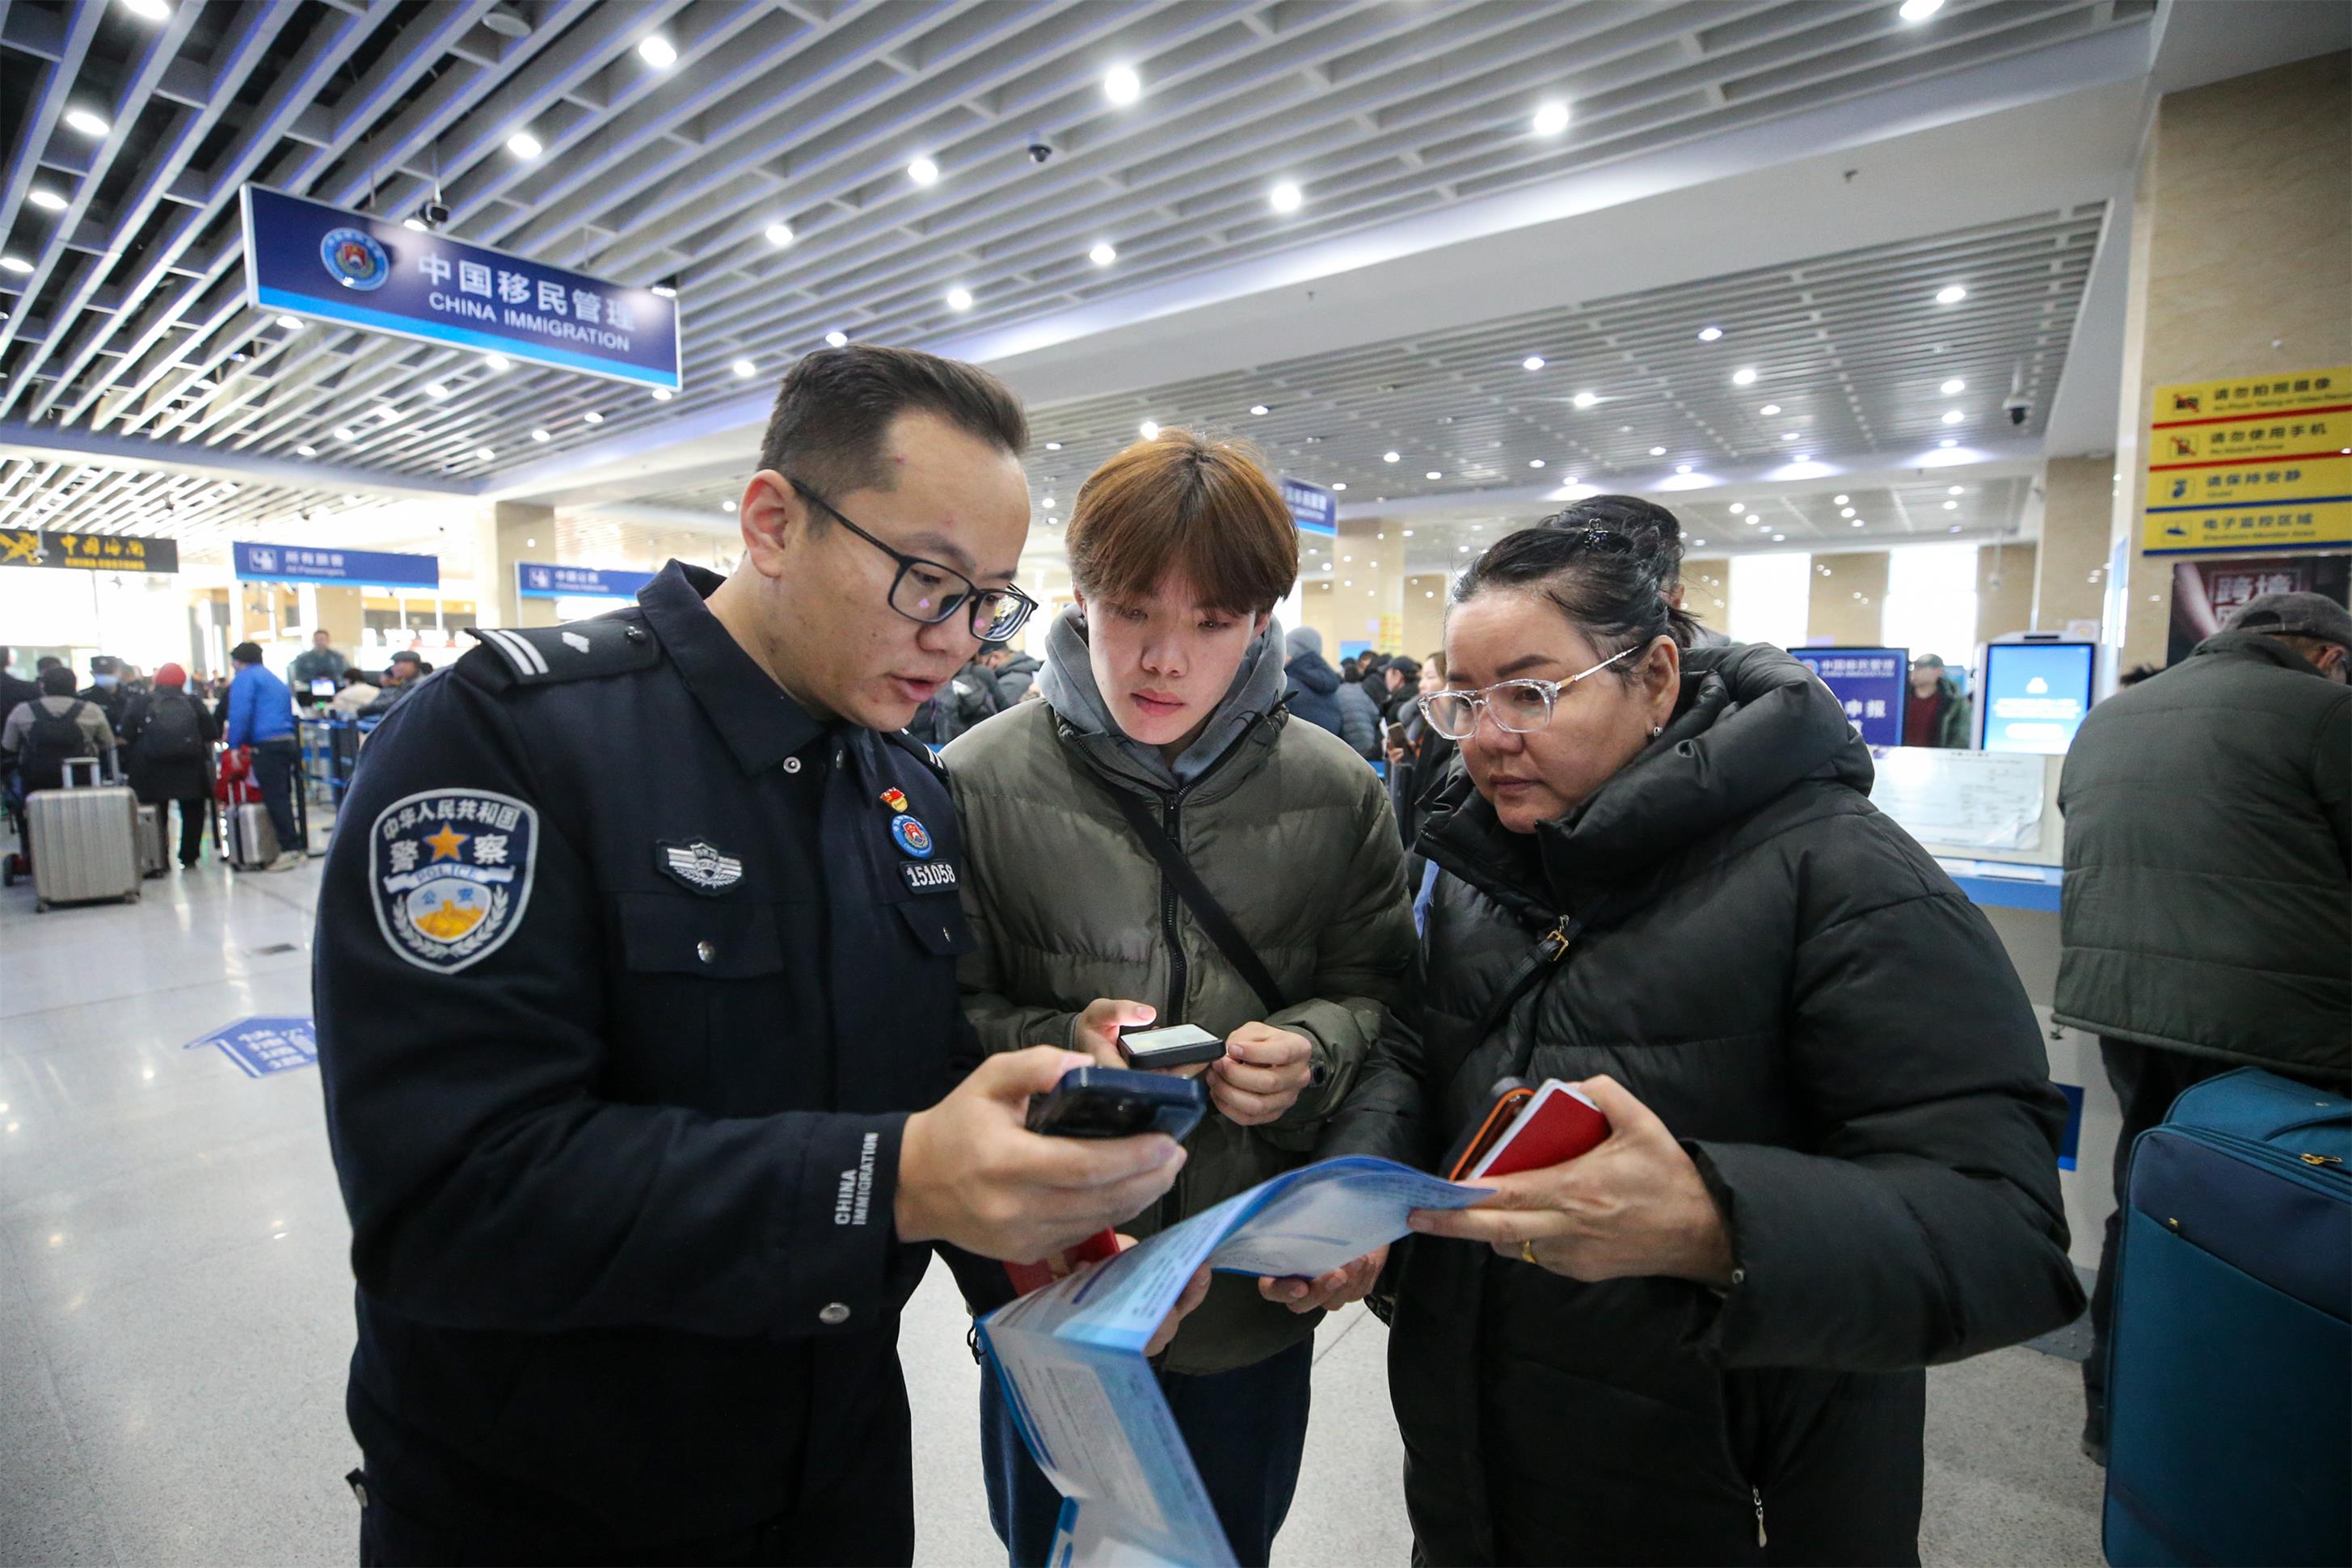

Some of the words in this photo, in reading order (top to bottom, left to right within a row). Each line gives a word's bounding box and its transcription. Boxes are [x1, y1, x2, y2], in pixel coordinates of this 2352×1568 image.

[418, 251, 634, 331] 中国移民管理
[428, 292, 496, 322] CHINA
[504, 308, 630, 352] IMMIGRATION
[383, 799, 522, 841] 中华人民共和国
[906, 864, 956, 887] 151058
[834, 1169, 858, 1225] CHINA
[851, 1132, 879, 1225] IMMIGRATION
